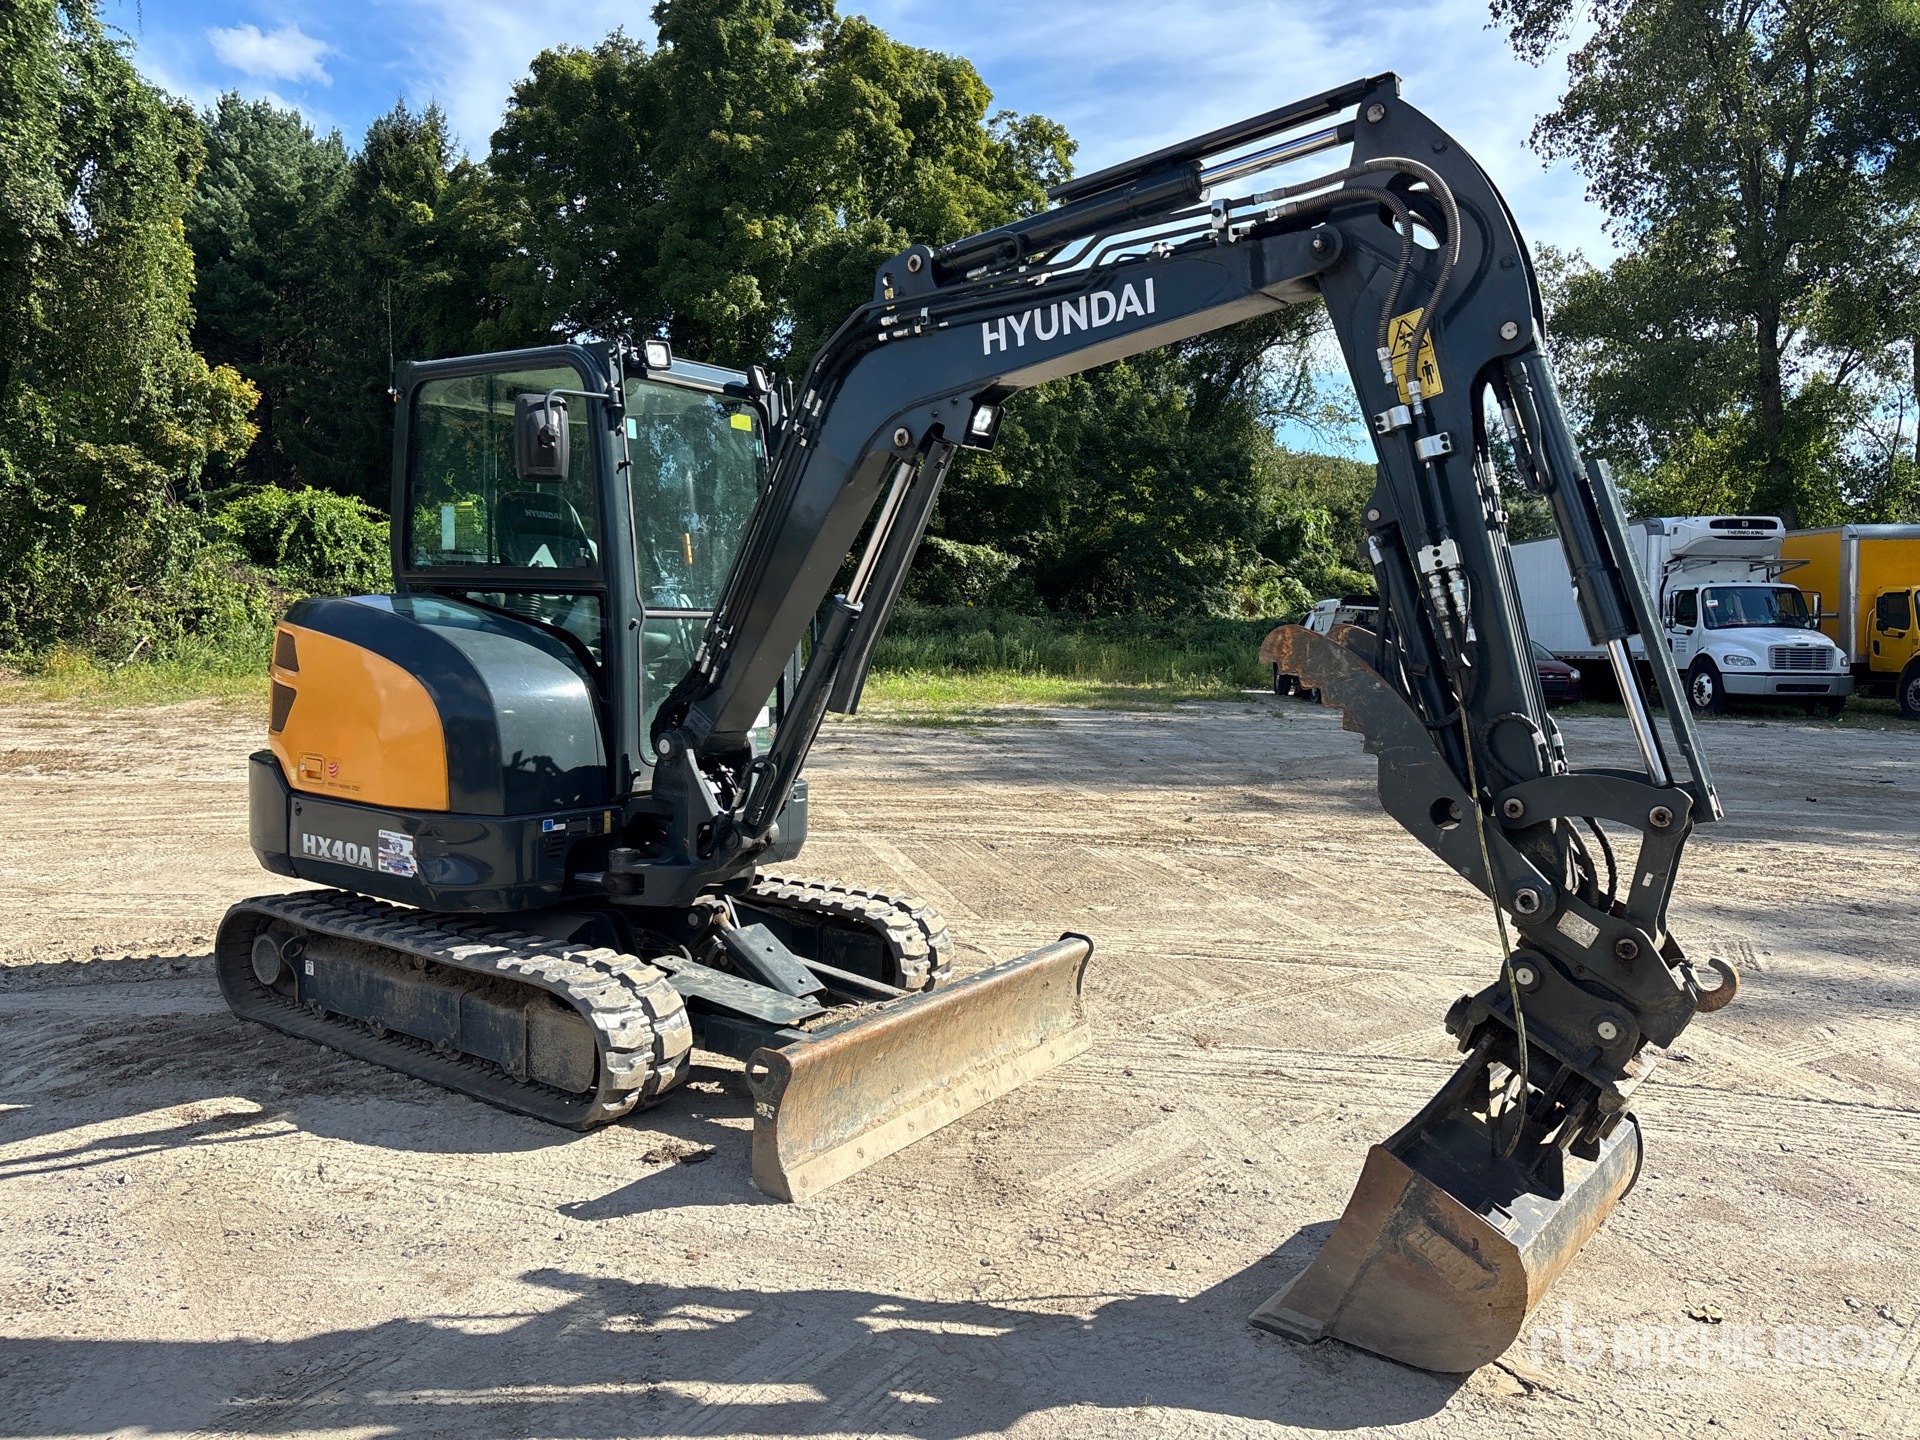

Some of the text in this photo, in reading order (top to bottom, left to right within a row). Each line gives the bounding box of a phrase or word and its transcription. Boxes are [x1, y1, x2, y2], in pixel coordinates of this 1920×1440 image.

[982, 277, 1155, 356] HYUNDAI
[525, 509, 562, 520] HYUNDAI
[302, 833, 374, 869] HX40A
